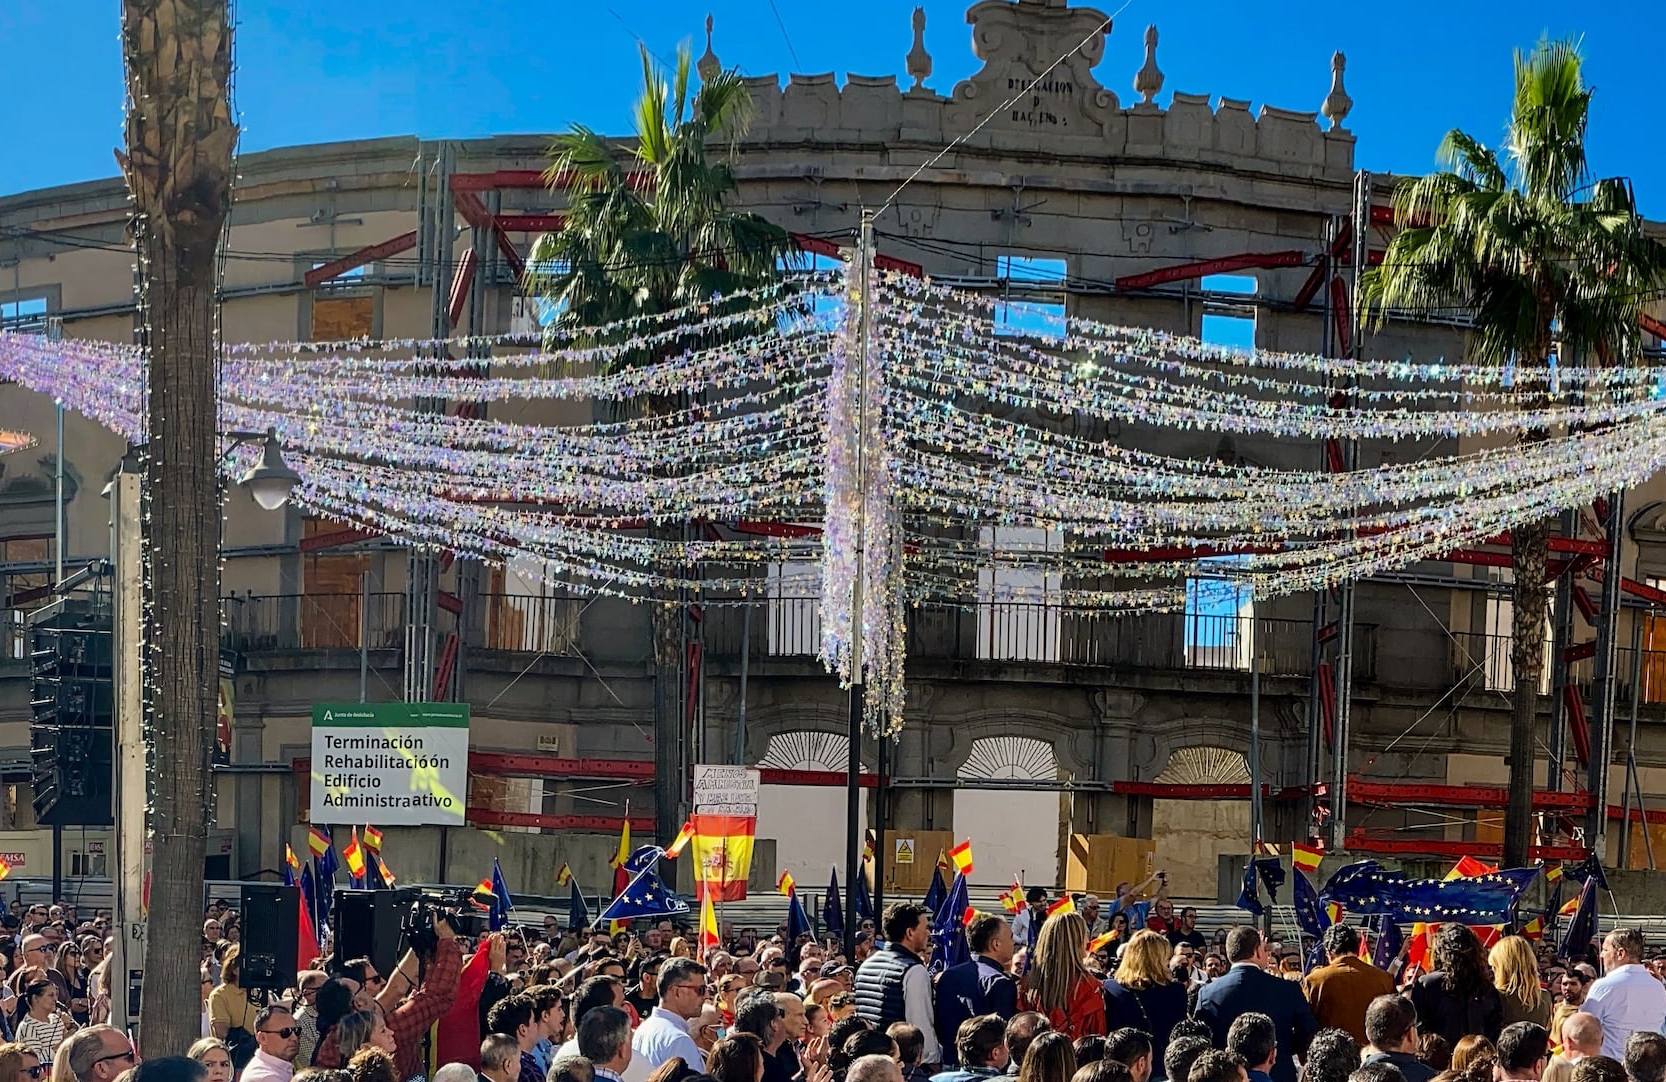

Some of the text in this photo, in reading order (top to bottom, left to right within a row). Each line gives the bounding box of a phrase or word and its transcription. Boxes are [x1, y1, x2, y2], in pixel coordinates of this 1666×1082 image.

[325, 735, 423, 749] Terminación
[324, 773, 381, 788] Edificio
[702, 768, 748, 779] MENOS
